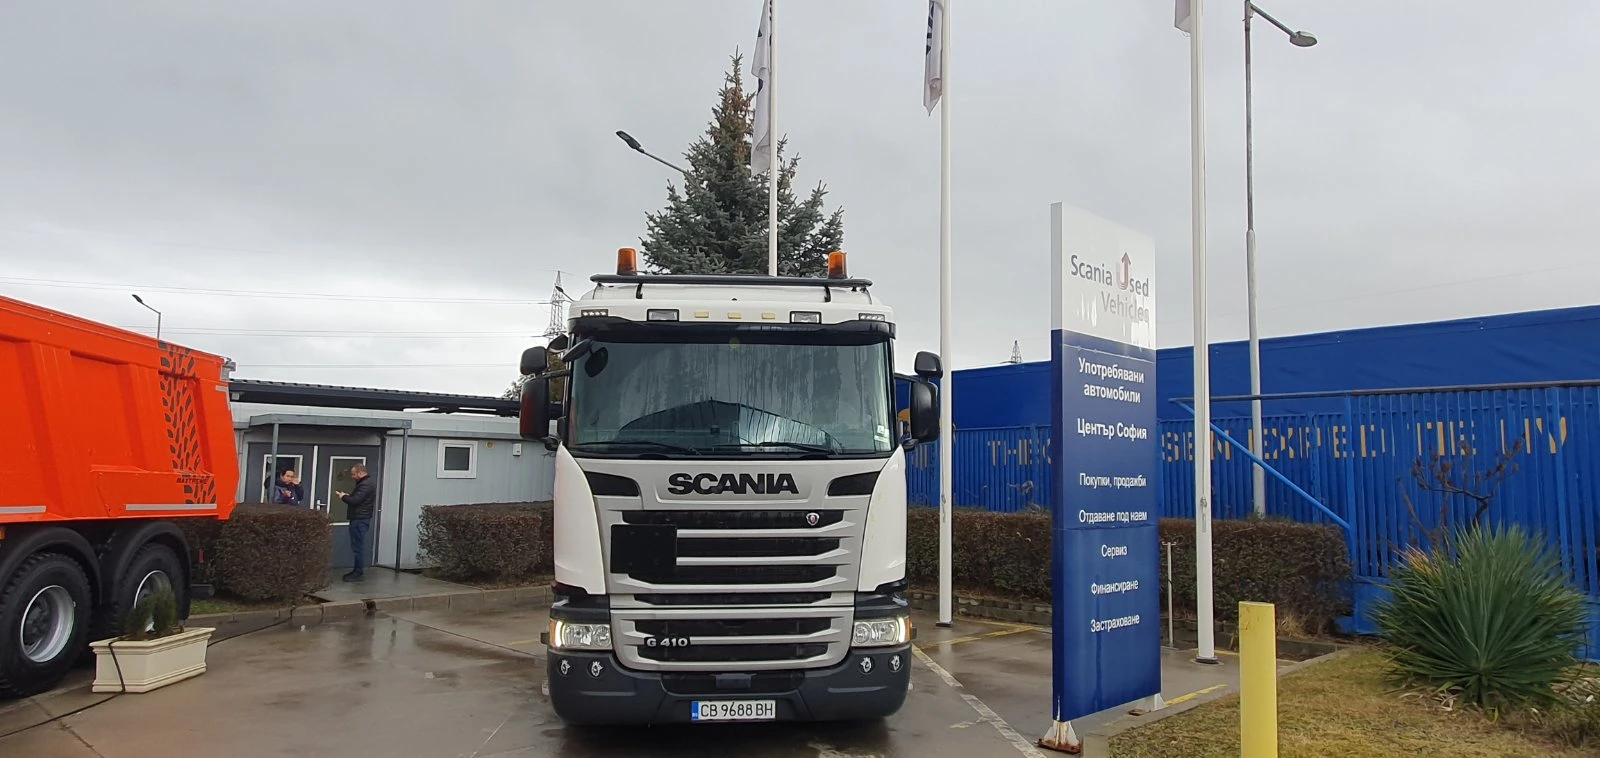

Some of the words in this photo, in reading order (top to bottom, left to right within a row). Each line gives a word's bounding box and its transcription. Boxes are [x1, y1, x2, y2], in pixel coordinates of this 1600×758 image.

[1070, 254, 1113, 287] Scania
[1116, 252, 1149, 298] Used
[1101, 291, 1149, 323] Vehicles
[1078, 357, 1145, 384] Употребявани
[1083, 382, 1141, 403] автомобили
[1077, 418, 1115, 439] Център
[1117, 422, 1148, 442] София
[667, 472, 800, 495] SCANIA
[1113, 475, 1147, 488] продажби
[1079, 509, 1115, 524] Отдаване
[1116, 511, 1130, 523] под
[1131, 510, 1148, 521] наем
[1101, 544, 1128, 559] Сервиз
[1091, 578, 1139, 595] Финансиране
[1090, 613, 1140, 633] Застраховане
[646, 637, 657, 648] G
[660, 637, 688, 647] 410
[701, 704, 718, 717] CB
[721, 701, 753, 717] 9688
[756, 703, 773, 716] BH
